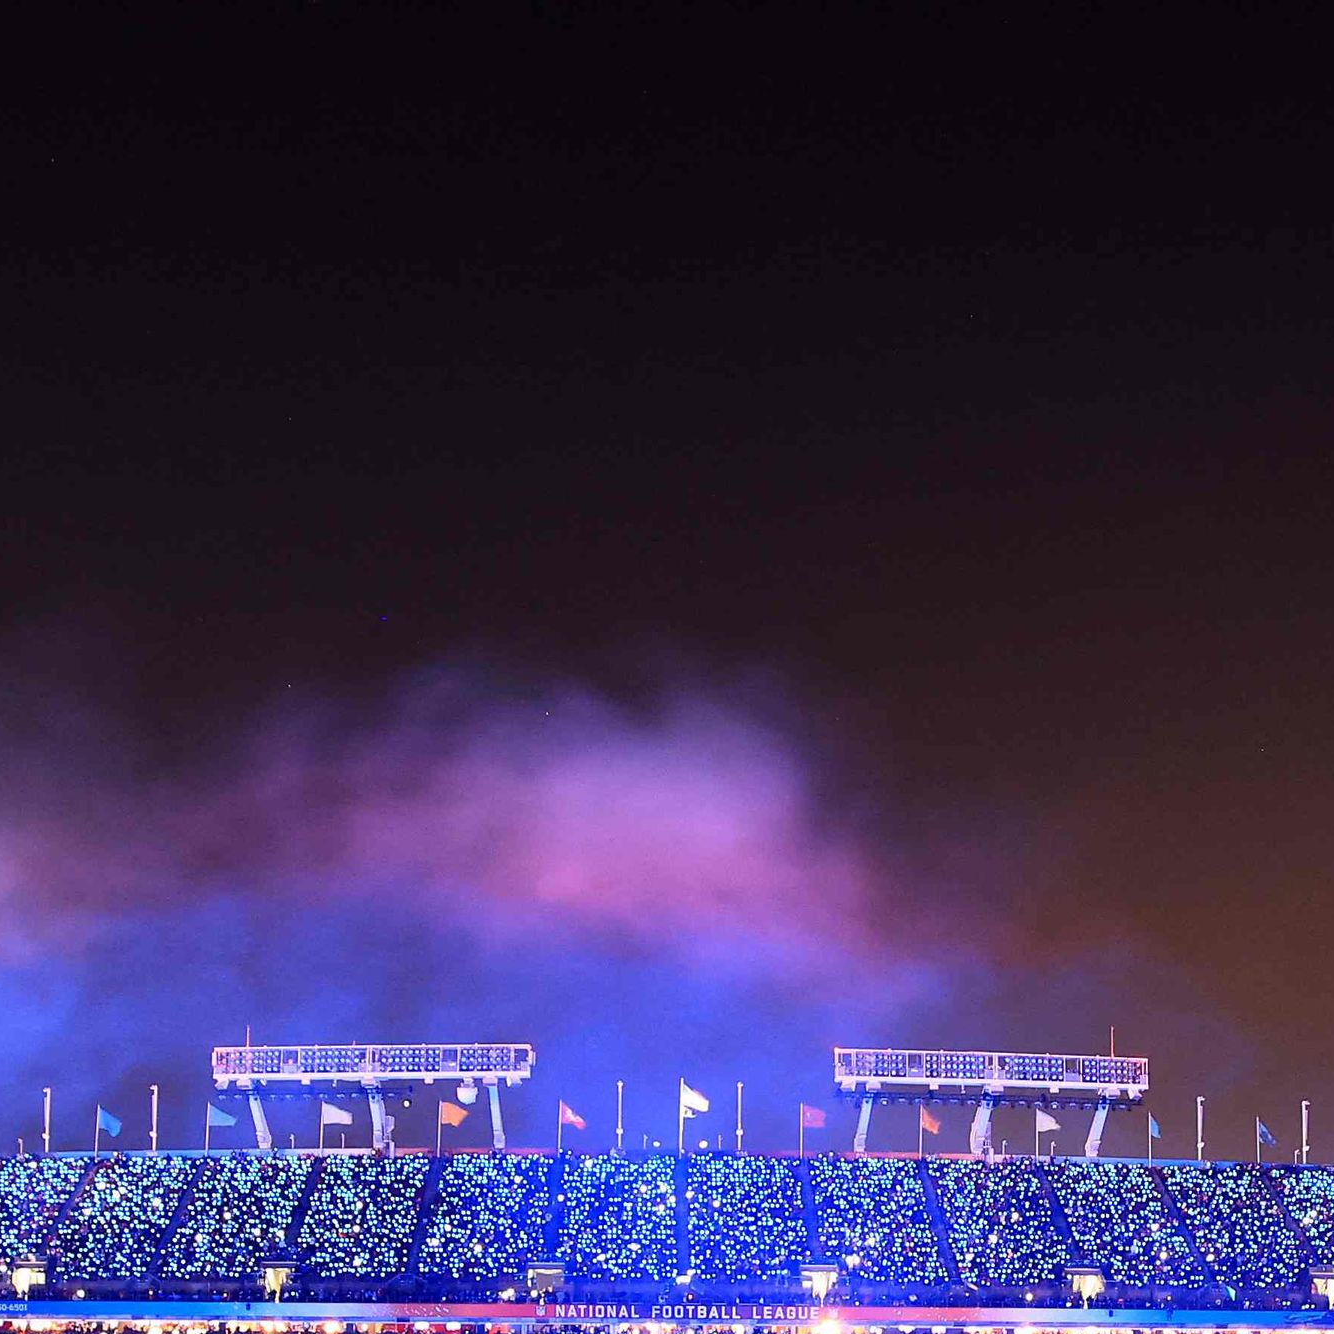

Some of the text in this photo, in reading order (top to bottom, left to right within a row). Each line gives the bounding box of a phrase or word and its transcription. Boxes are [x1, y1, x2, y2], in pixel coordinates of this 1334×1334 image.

[555, 1305, 640, 1318] NATIONAL
[651, 1305, 741, 1319] FOOTBALL
[752, 1306, 820, 1320] LEAGUE
